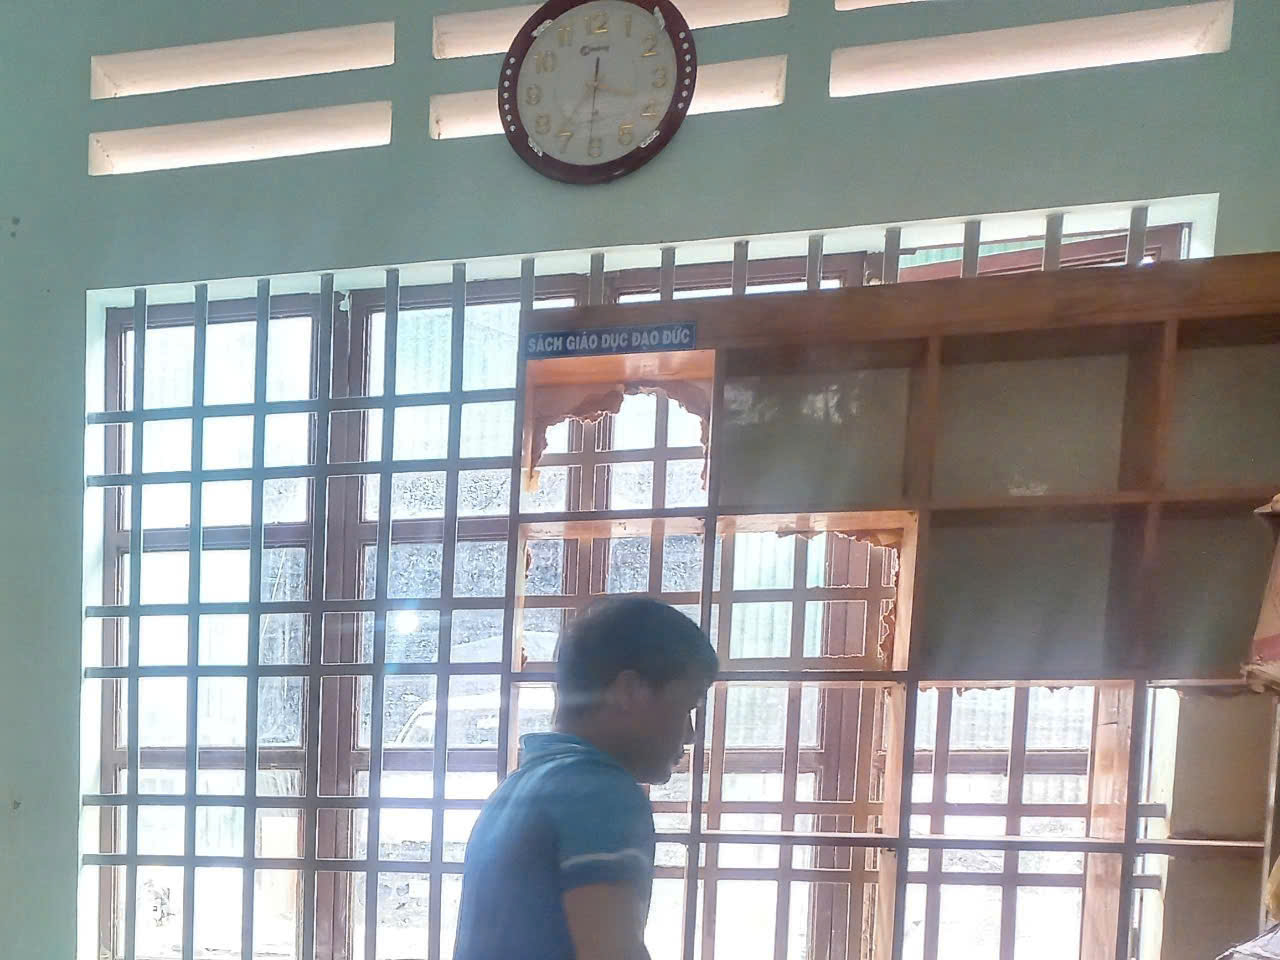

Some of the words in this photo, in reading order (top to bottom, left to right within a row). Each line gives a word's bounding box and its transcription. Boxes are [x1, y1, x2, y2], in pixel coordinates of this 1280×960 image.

[584, 10, 609, 36] 12
[623, 15, 633, 38] 1
[557, 24, 573, 48] 11
[641, 32, 658, 58] 2
[534, 51, 558, 74] 10
[652, 64, 667, 89] 3
[526, 84, 541, 106] 9
[640, 100, 657, 121] 4
[535, 113, 551, 135] 8
[618, 122, 633, 146] 5
[557, 128, 574, 154] 7
[587, 137, 603, 158] 6
[528, 334, 563, 353] SÁCH
[566, 331, 599, 350] GIÁO
[601, 334, 629, 352] DỤC
[631, 331, 660, 350] ĐẠO
[662, 327, 691, 345] ĐỨC
